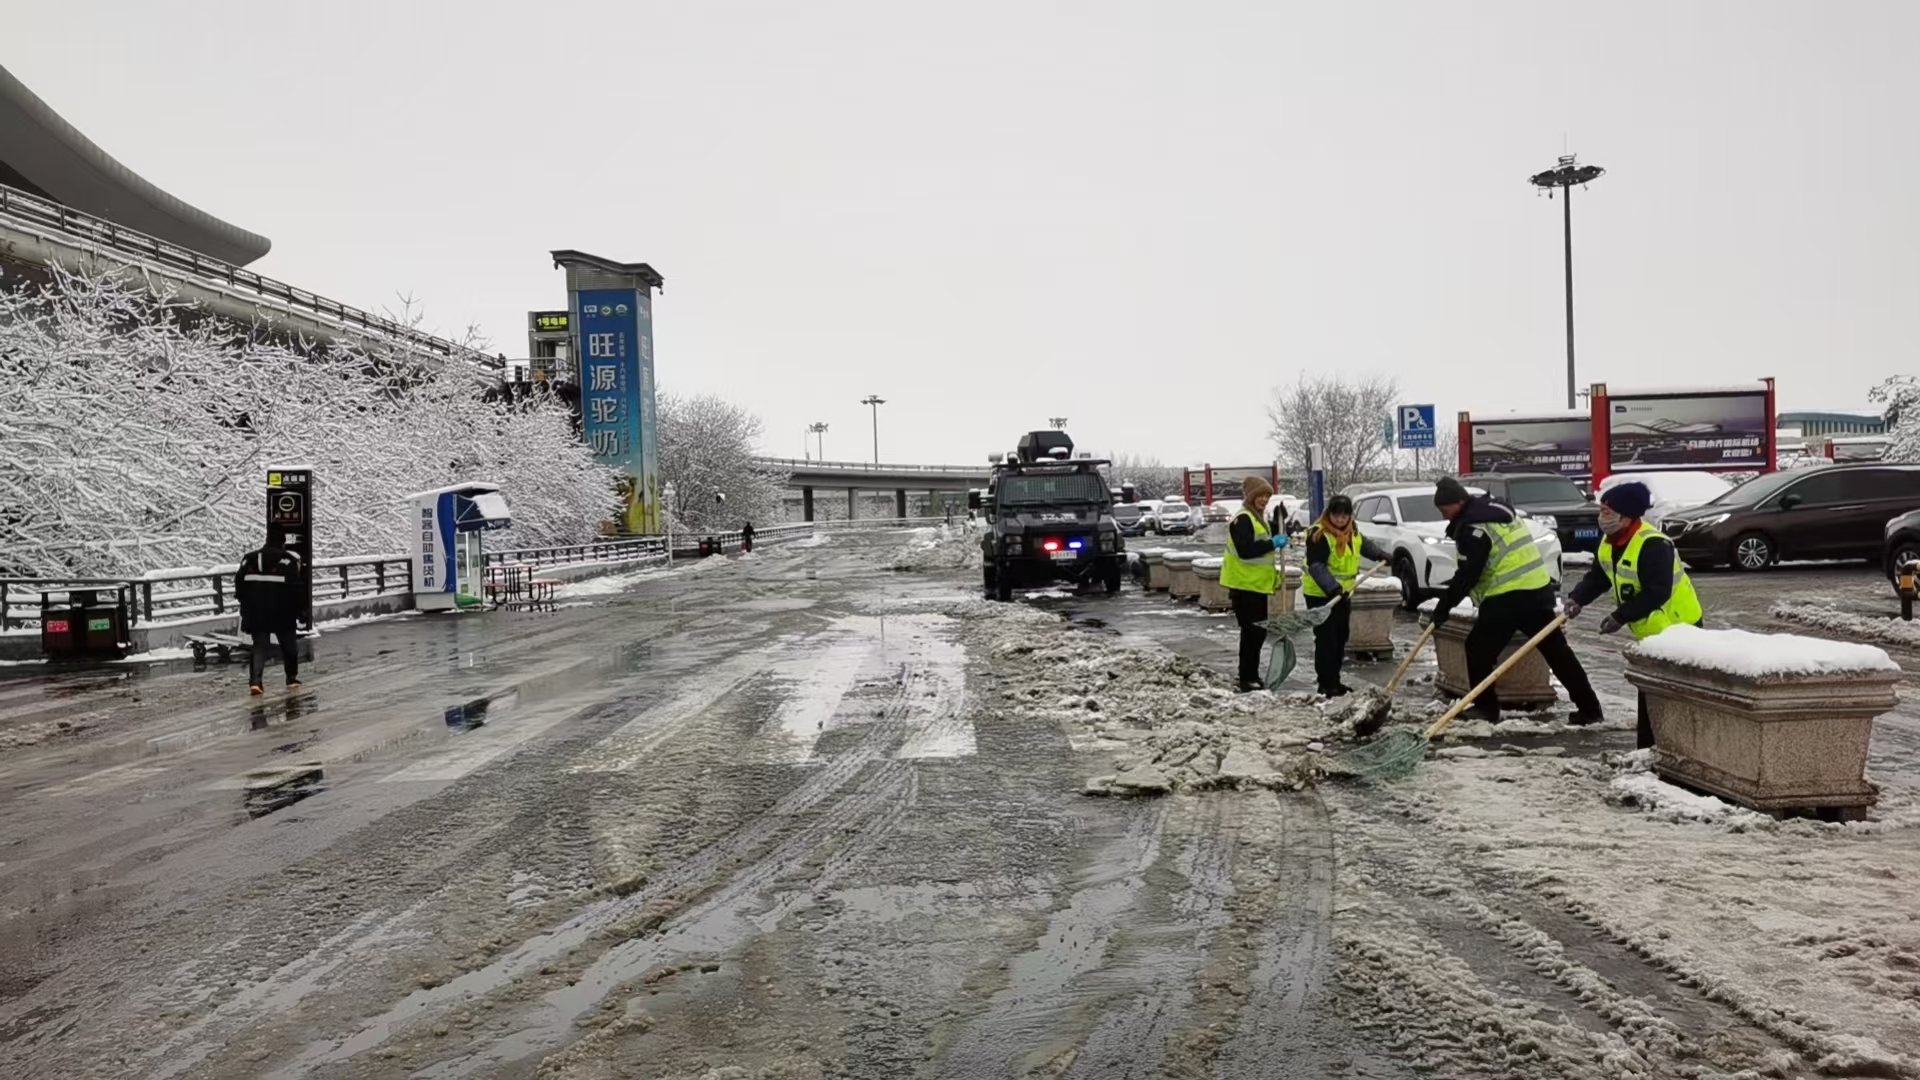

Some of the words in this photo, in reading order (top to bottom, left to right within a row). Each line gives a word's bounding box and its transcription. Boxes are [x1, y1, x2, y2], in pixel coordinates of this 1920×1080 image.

[589, 333, 618, 458] 旺源驼奶
[1404, 408, 1420, 430] P
